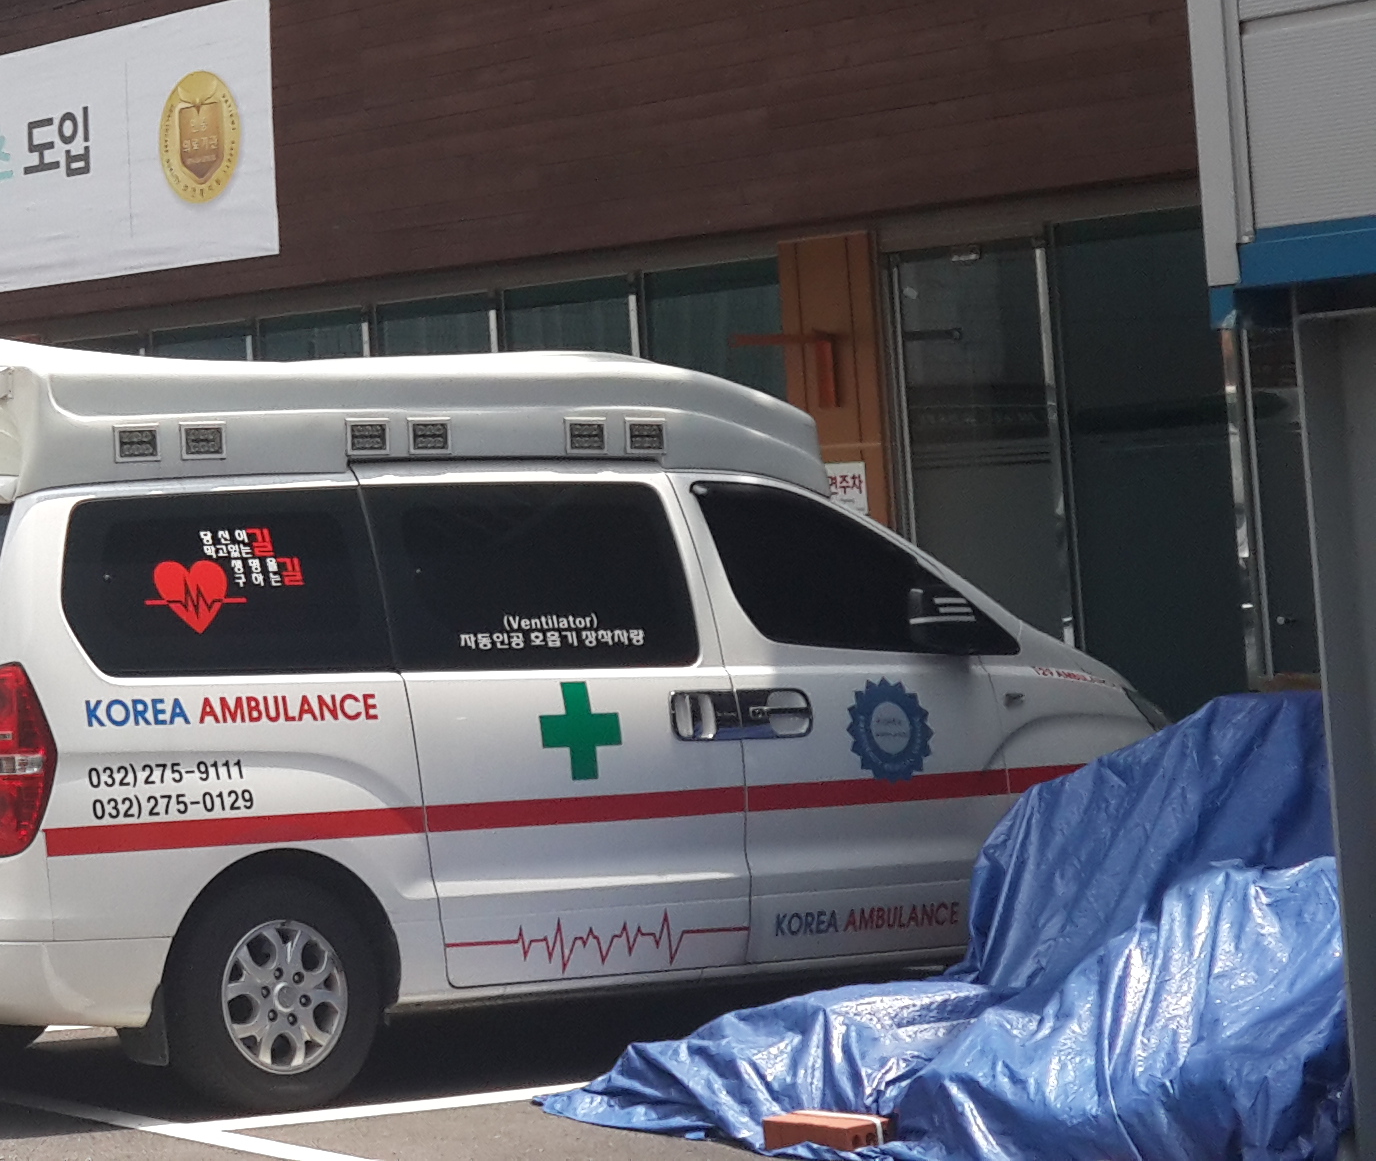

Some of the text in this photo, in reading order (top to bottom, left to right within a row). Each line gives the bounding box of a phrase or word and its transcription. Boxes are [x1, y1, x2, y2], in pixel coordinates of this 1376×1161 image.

[23, 105, 91, 178] 도입
[246, 527, 275, 557] 길
[234, 572, 282, 588] 구하는
[276, 556, 306, 586] 길
[503, 613, 598, 630] (Ventilator)
[459, 629, 645, 650] 자동인공 호흡기 장착차량
[84, 693, 379, 728] KOREA AMBULANCE
[775, 901, 960, 936] KOREA AMBULANCE
